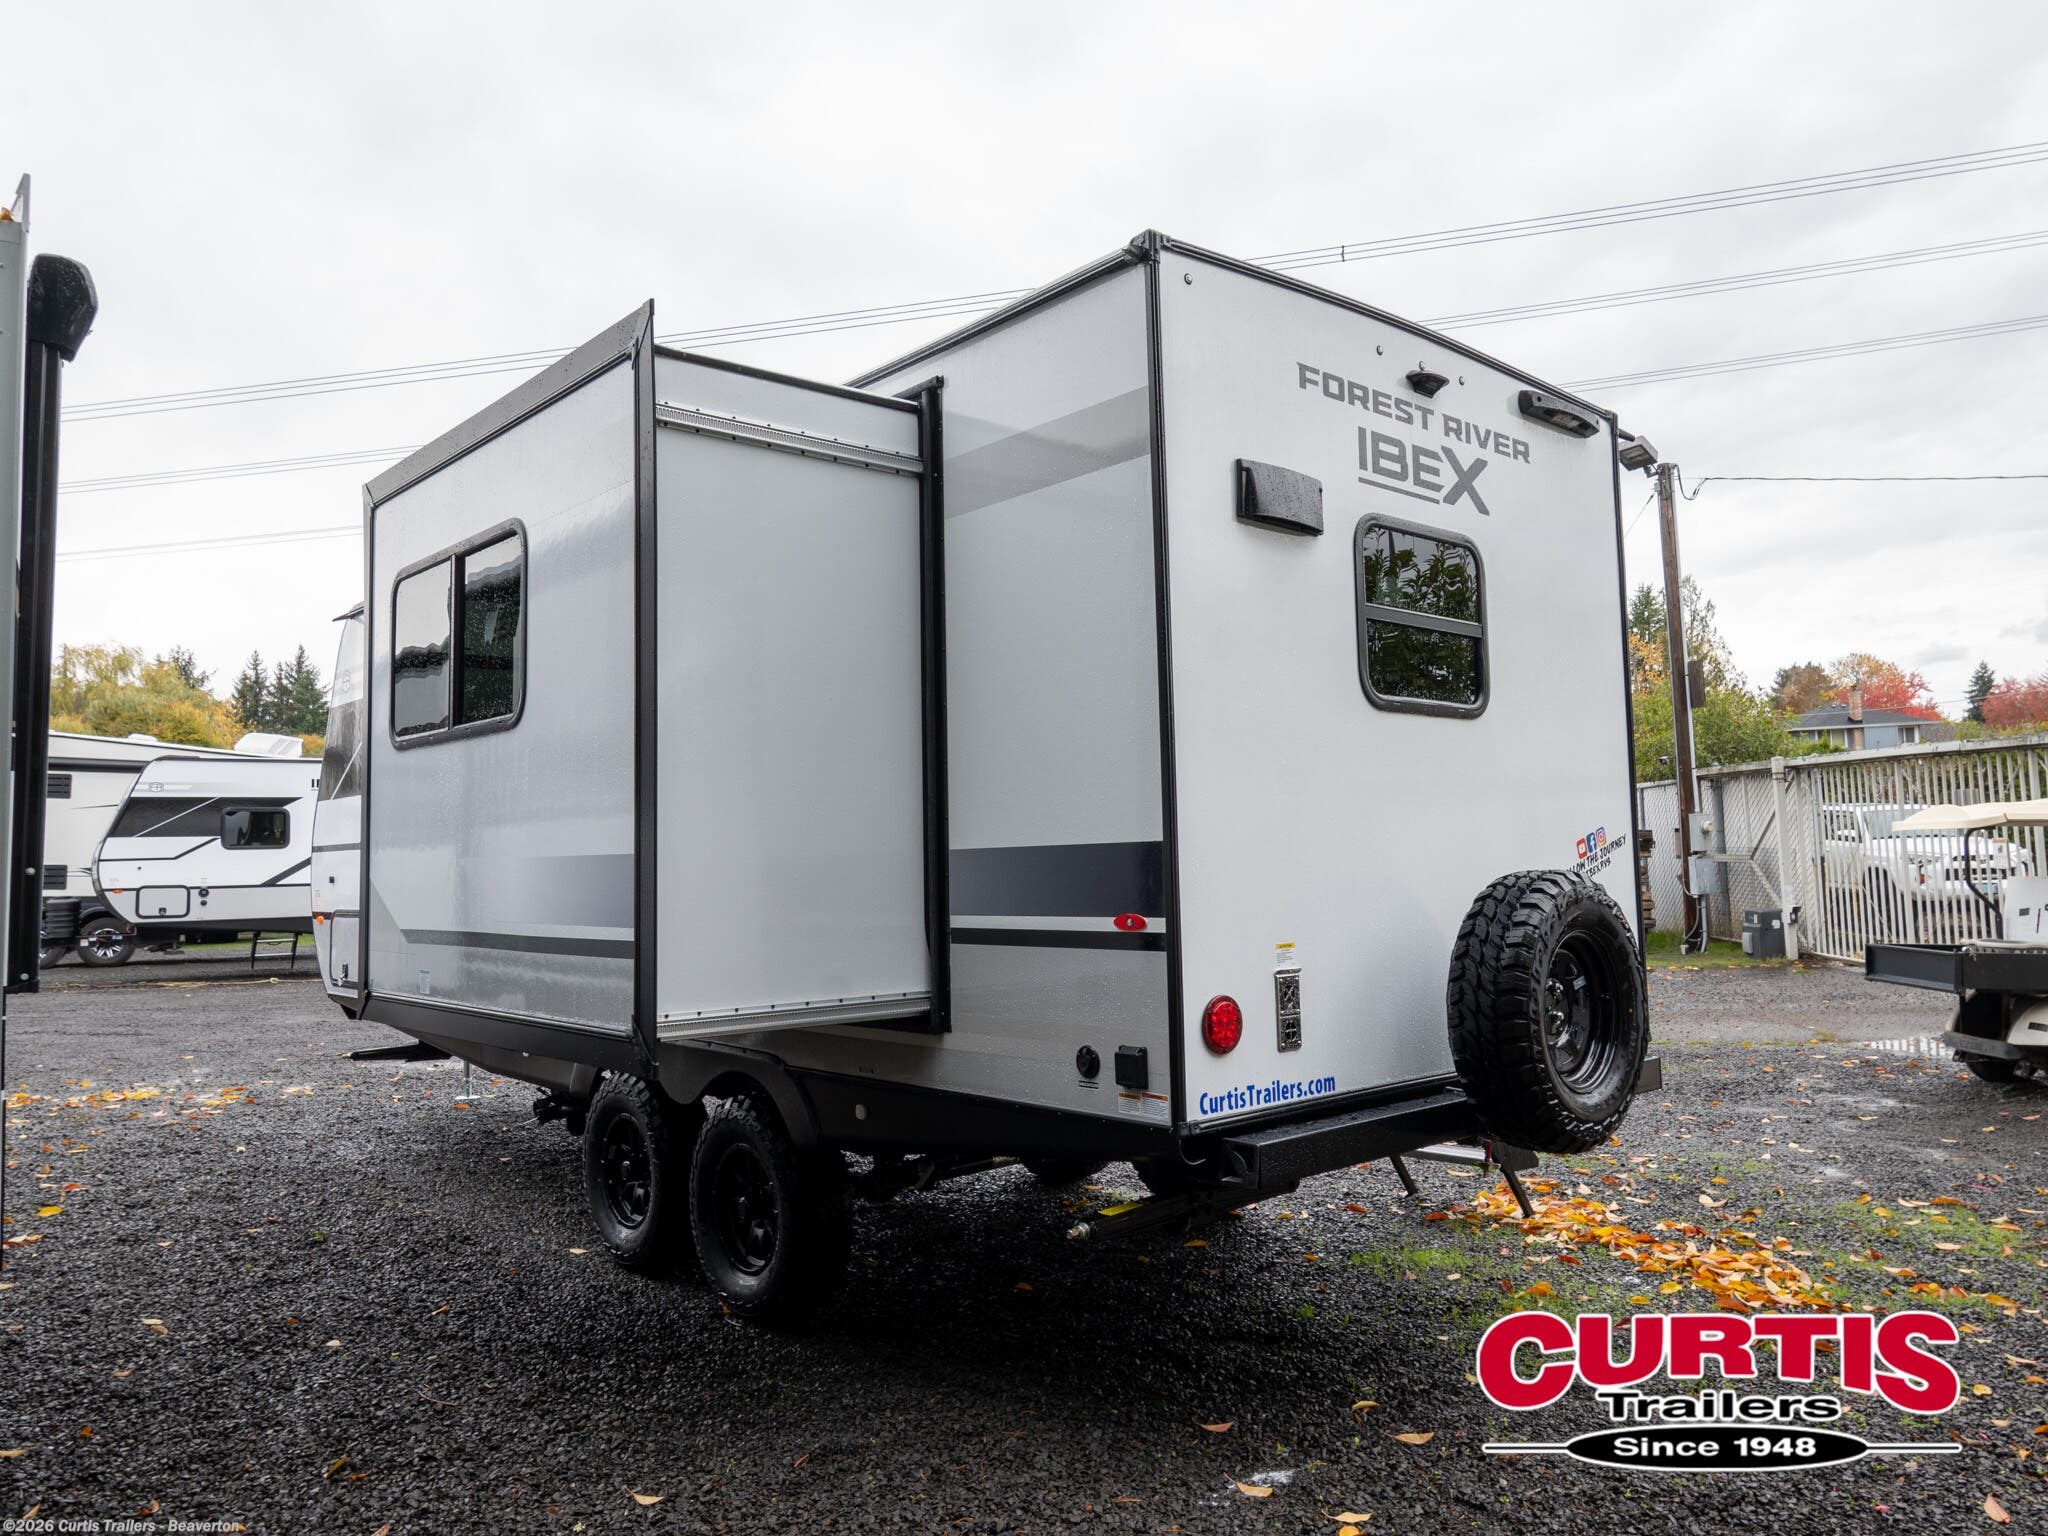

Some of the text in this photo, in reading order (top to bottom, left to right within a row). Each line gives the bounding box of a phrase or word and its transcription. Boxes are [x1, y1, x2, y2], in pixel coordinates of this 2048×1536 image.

[1297, 361, 1531, 464] FOREST RIVER
[1357, 425, 1490, 516] IBEX
[1586, 850, 1599, 867] THE
[1600, 833, 1626, 859] JOURNEY
[1199, 1076, 1336, 1115] CurtisTrailers.com
